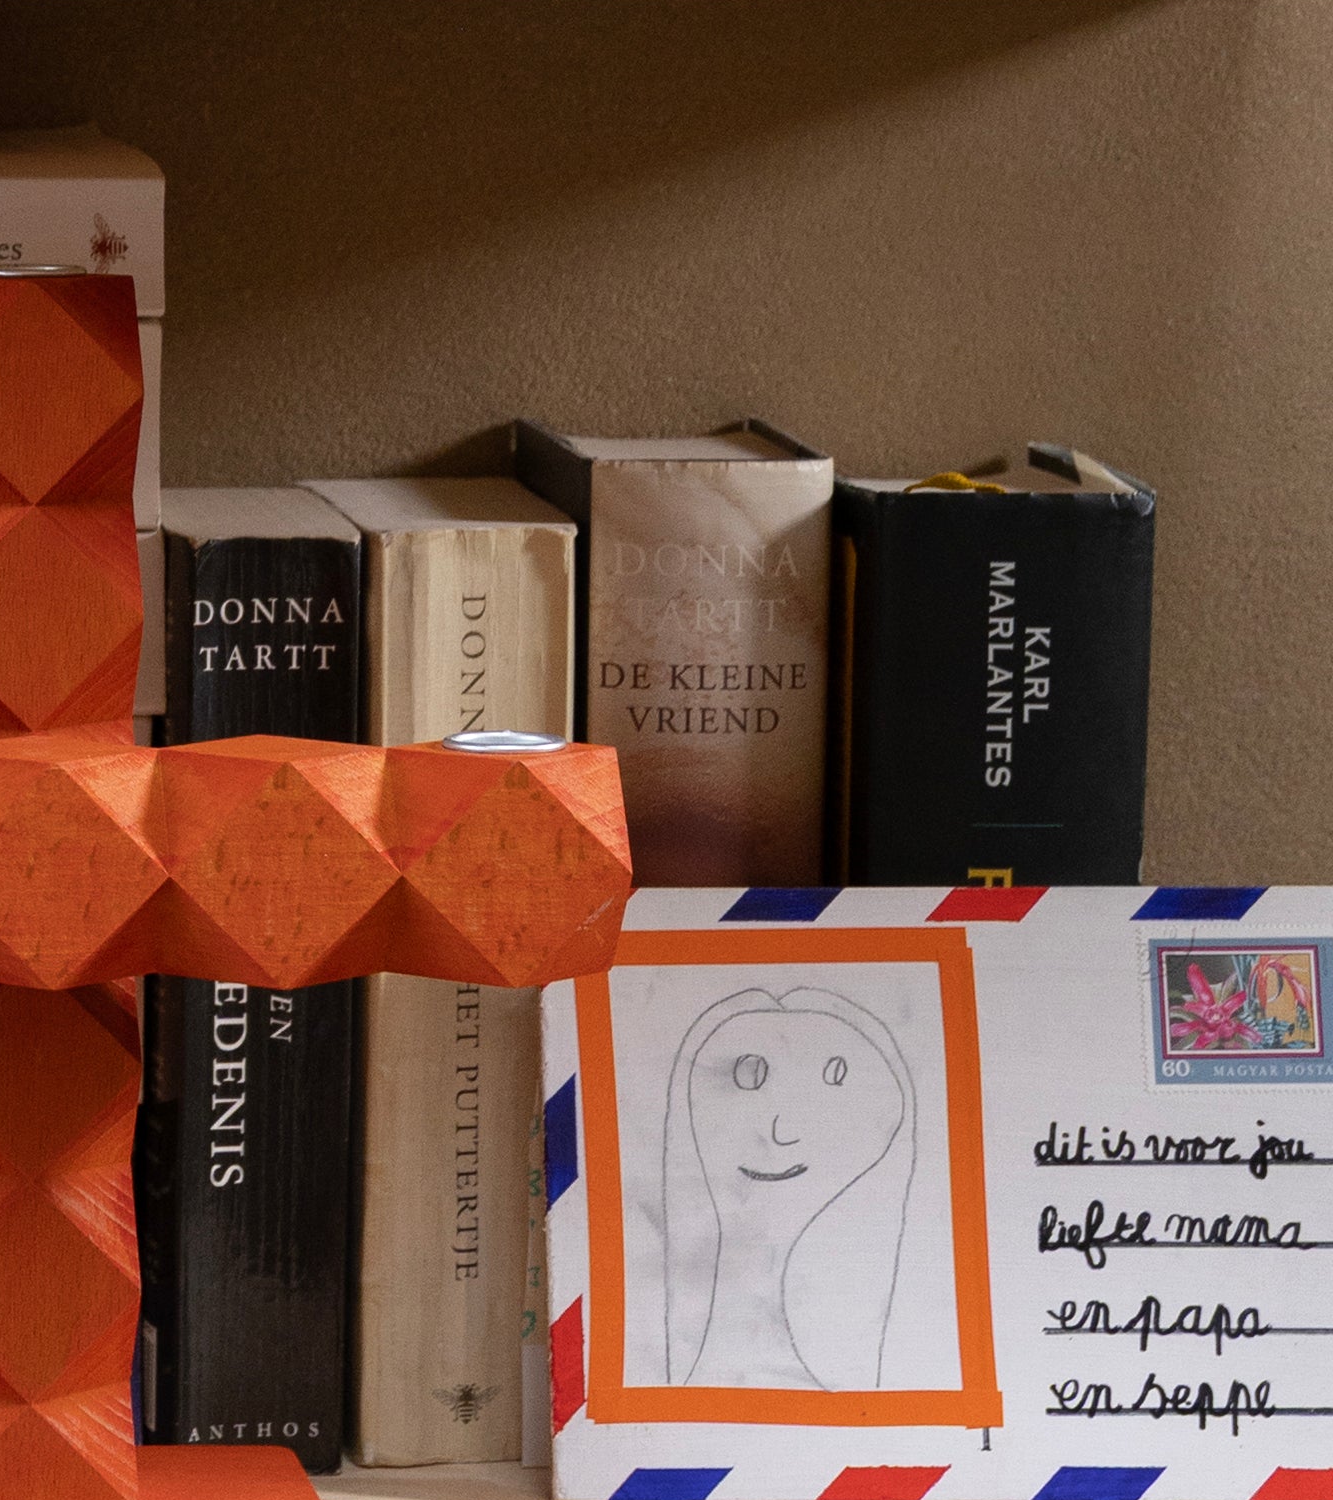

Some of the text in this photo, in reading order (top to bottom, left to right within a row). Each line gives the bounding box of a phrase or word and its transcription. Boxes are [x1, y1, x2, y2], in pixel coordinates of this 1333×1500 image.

[193, 599, 345, 628] DONNA
[199, 644, 337, 673] TARTT
[983, 559, 1017, 790] MARLANTES
[600, 662, 807, 692] DE KLEINE
[1023, 626, 1052, 725] KARL
[626, 706, 781, 737] VRIEND
[1161, 1059, 1333, 1078] 60 MAGYAR POSTA
[1035, 1121, 1315, 1178] dit is voor jou
[1164, 1214, 1317, 1248] mama
[1046, 1296, 1273, 1356] en papa
[1051, 1382, 1124, 1415] en
[188, 1422, 320, 1442] ANTHOS
